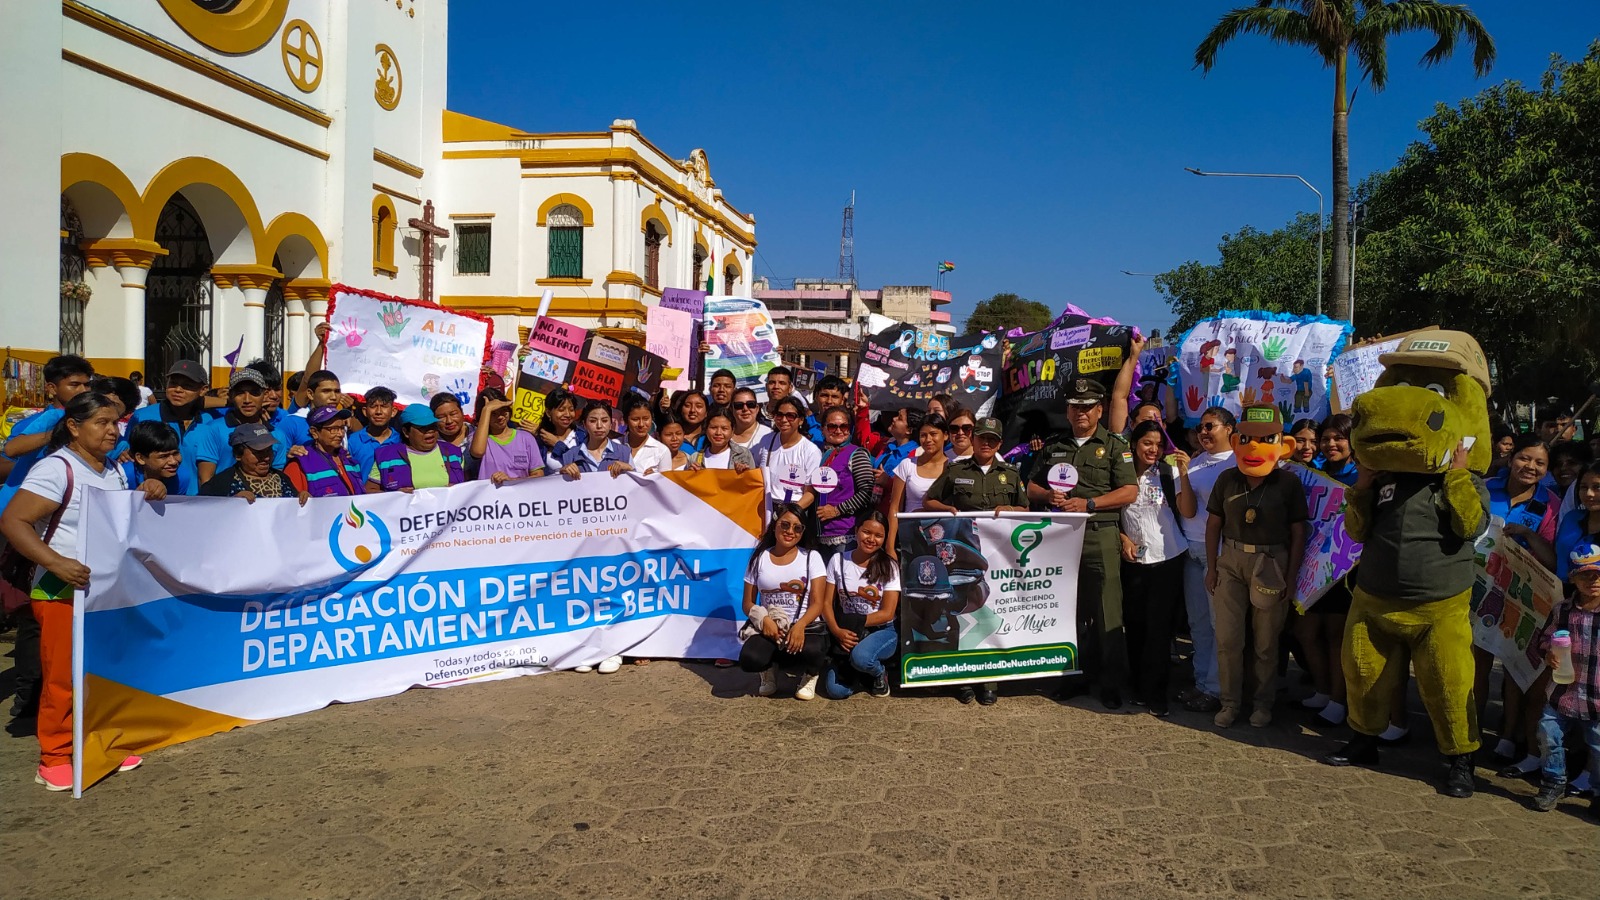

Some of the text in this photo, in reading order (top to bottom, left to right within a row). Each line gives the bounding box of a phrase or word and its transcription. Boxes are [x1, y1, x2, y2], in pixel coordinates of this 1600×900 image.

[383, 309, 404, 327] NO
[421, 319, 456, 337] A LA
[538, 320, 569, 338] NO AL
[531, 331, 580, 355] MALTRATO
[648, 342, 669, 356] PARA
[927, 333, 949, 348] DE
[1411, 341, 1448, 351] FELCV
[578, 365, 616, 387] NO A LA
[572, 376, 620, 399] VIOLENCIA
[522, 391, 546, 412] LE
[1247, 411, 1271, 420] FELCV
[399, 495, 628, 533] DEFENSORÍA DEL PUEBLO
[400, 513, 628, 545] ESTADO PLURINACIONAL DE BOLIVIA
[453, 536, 497, 548] Nacional
[499, 534, 512, 544] de
[514, 529, 568, 543] Prevención
[570, 529, 583, 538] de
[584, 528, 593, 538] la
[595, 526, 628, 537] Tortura
[990, 566, 1063, 580] UNIDAD DE
[240, 556, 711, 633] DELEGACIÓN DEFENSORIAL
[1000, 579, 1053, 593] GÉNERO
[993, 601, 1059, 615] LOS DERECHOS DE
[995, 593, 1055, 606] FORTALECIENDO
[242, 585, 691, 673] DEPARTAMENTAL DE BENI
[995, 614, 1058, 635] La Mujer
[433, 656, 463, 668] Todas
[465, 656, 471, 666] y
[473, 650, 502, 662] todos
[425, 664, 486, 682] Defensores
[489, 659, 506, 670] del
